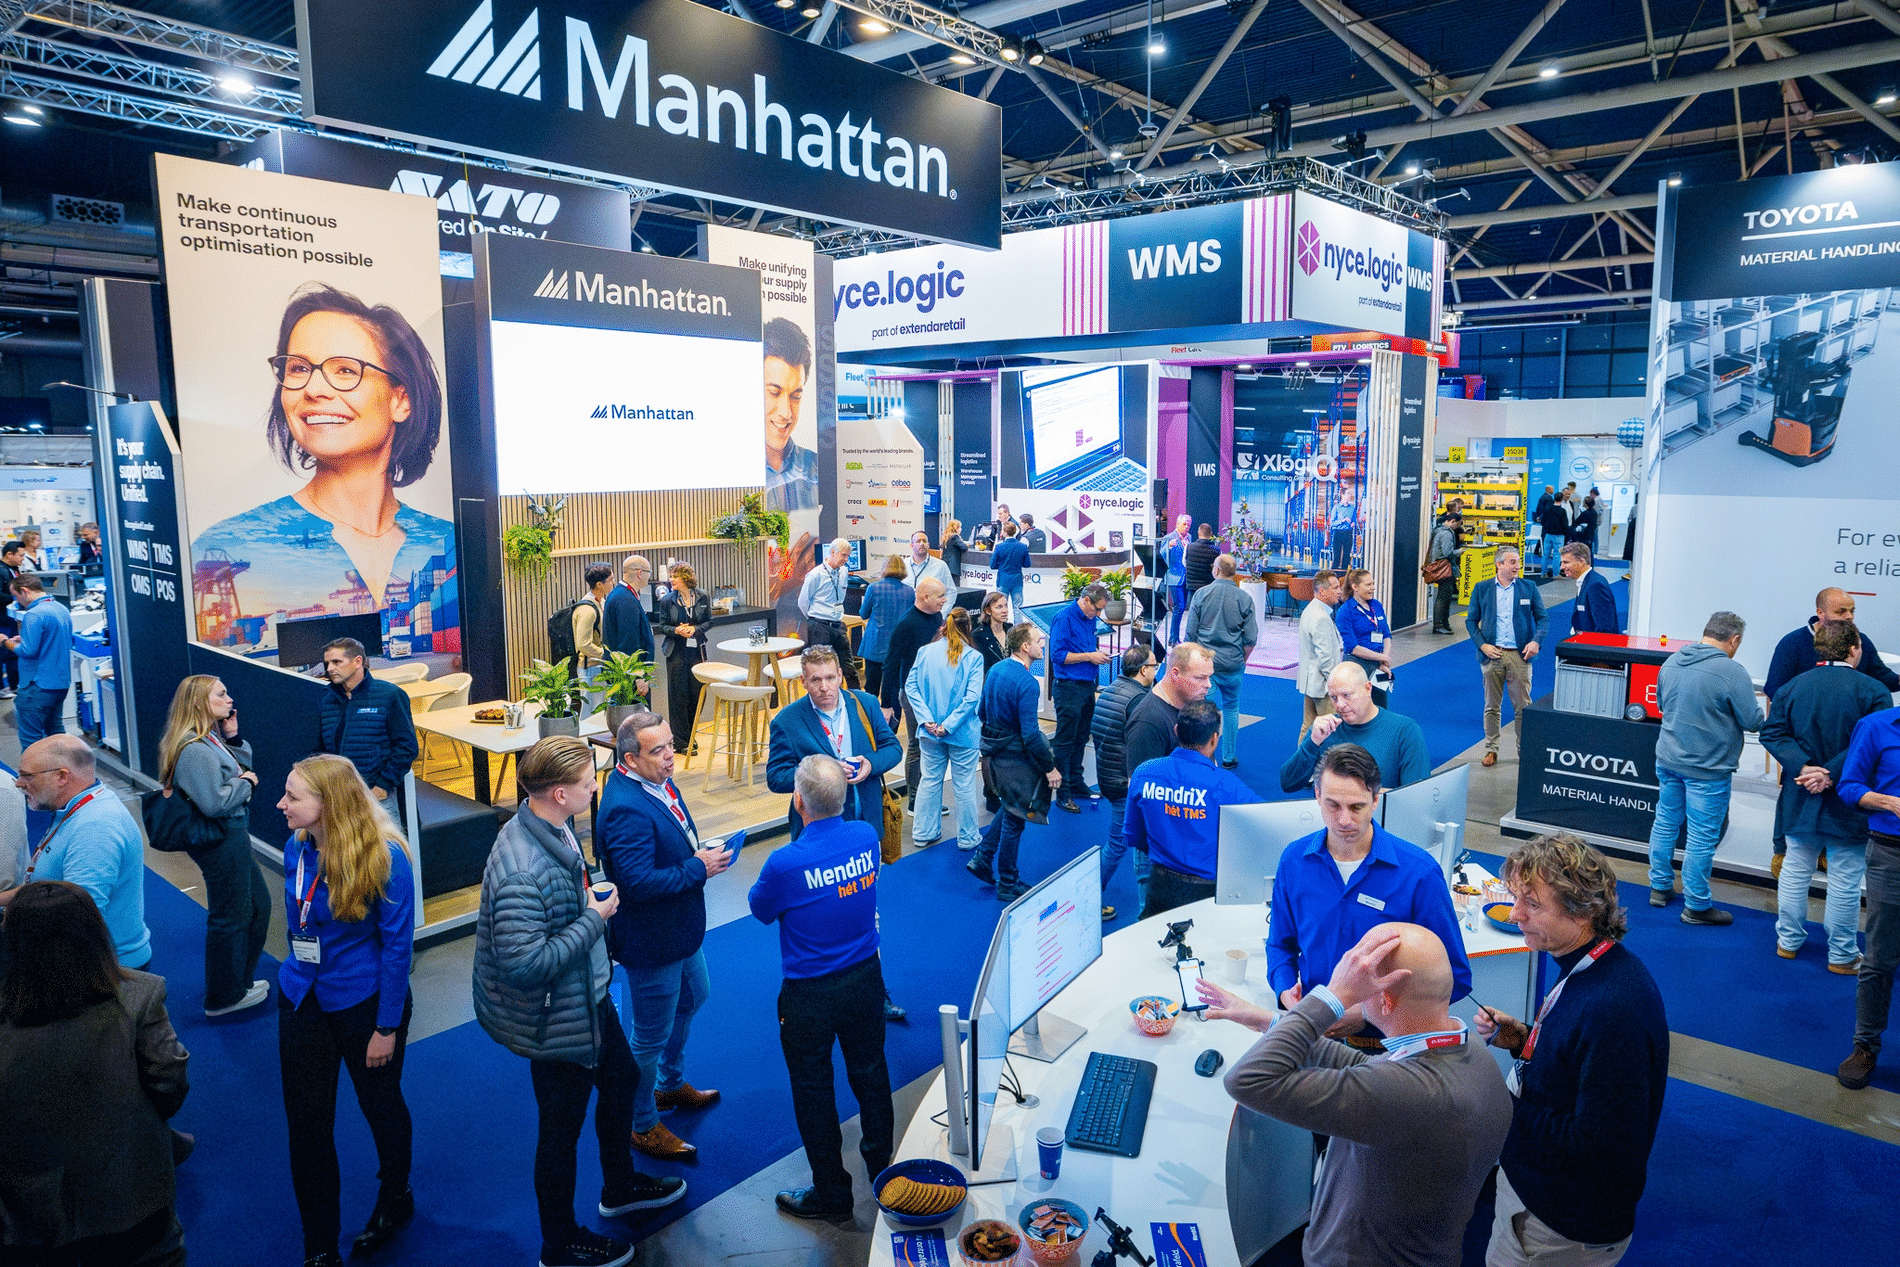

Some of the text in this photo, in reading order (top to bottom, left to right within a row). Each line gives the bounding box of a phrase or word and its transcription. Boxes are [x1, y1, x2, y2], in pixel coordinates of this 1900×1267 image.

[177, 192, 338, 229] Make continuous
[1743, 200, 1859, 230] TOYOTA
[178, 212, 314, 243] transportation
[180, 235, 373, 268] optimisation possible
[1127, 238, 1222, 280] WMS
[1740, 247, 1818, 267] MATERIAL
[739, 256, 807, 279] Make unifying
[1324, 242, 1433, 293] nyce.logic WMS
[775, 278, 808, 292] supply
[767, 291, 808, 304] possible
[872, 318, 966, 341] part of extendaretail
[1352, 342, 1389, 351] LOGISTICS
[846, 372, 865, 382] Fleet
[611, 404, 695, 420] Manhattan
[119, 461, 142, 483] supply
[1194, 463, 1216, 477] WMS
[1093, 497, 1144, 511] nyce.logic
[1837, 528, 1900, 547] For e
[126, 539, 173, 566] WMS TMS
[1834, 560, 1847, 574] a
[131, 573, 176, 602] OMS POS
[1546, 748, 1639, 777] TOYOTA
[1143, 782, 1208, 807] MendriX
[1542, 783, 1606, 804] MATERIAL
[1183, 806, 1207, 820] TMS
[804, 849, 875, 890] MendriX
